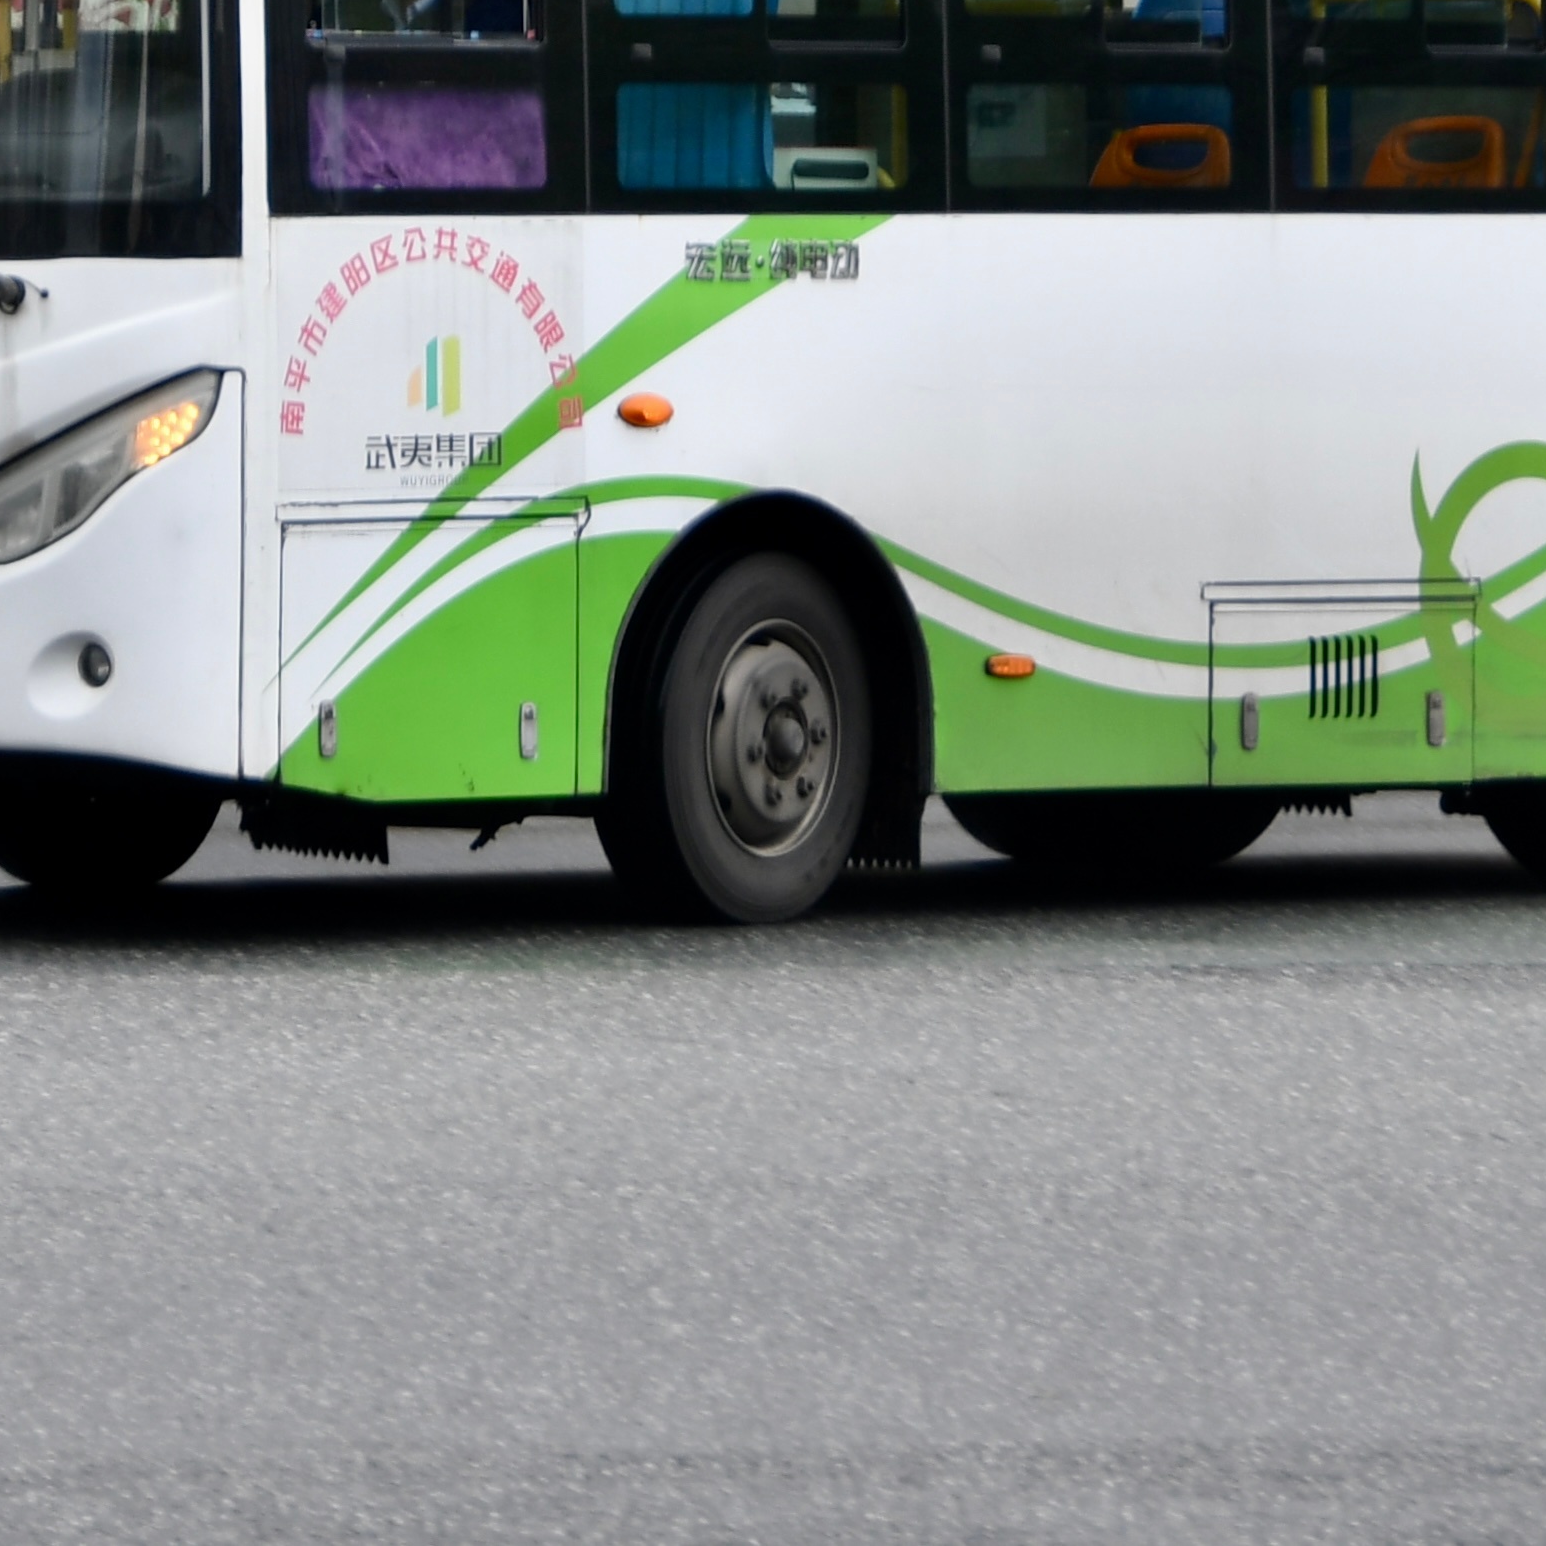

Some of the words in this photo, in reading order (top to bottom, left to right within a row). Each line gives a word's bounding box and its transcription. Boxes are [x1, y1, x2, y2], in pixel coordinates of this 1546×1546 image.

[280, 226, 584, 435] 南平市建阳区公共交通有限公司
[365, 433, 503, 470] 武夷集团
